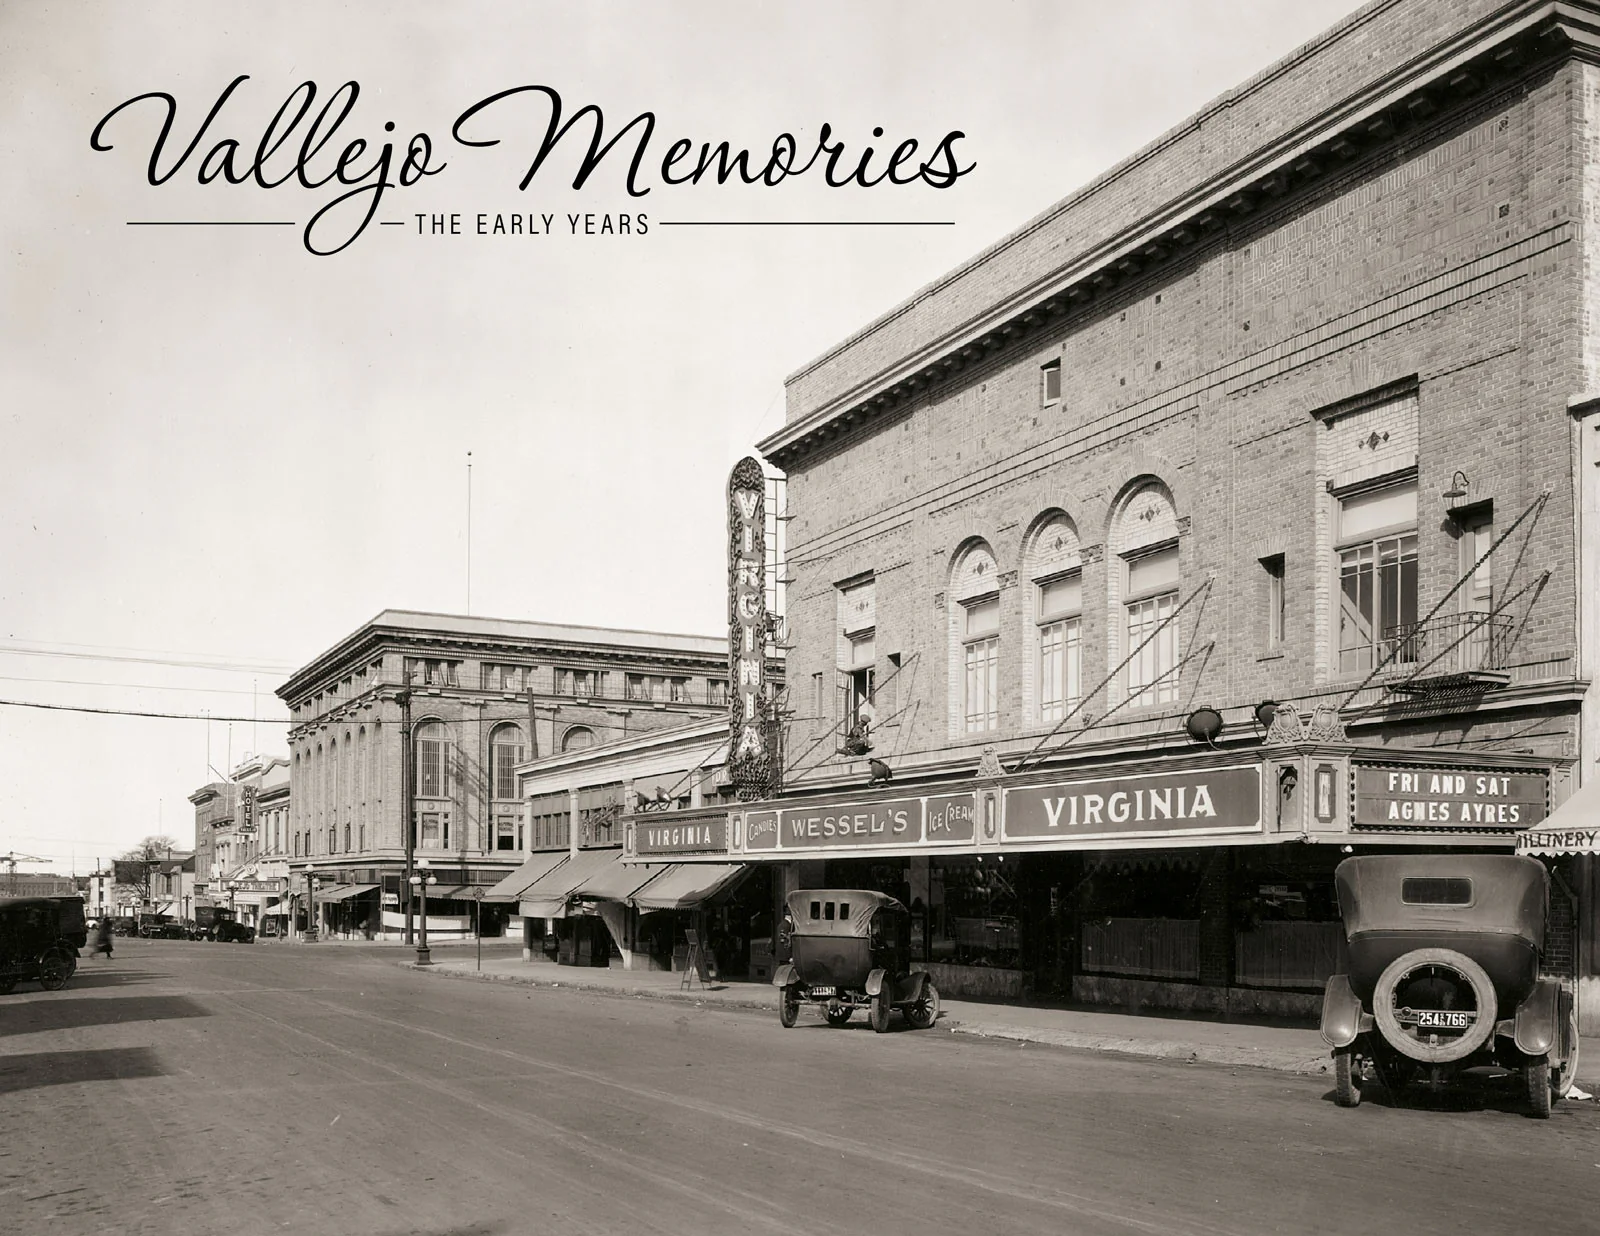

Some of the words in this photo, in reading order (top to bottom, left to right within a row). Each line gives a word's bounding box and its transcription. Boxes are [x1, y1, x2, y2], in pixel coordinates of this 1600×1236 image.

[735, 489, 761, 752] VIRGINIA
[1388, 773, 1419, 793] FRI
[1430, 775, 1466, 794] AND
[1476, 777, 1511, 796] SAT
[1042, 785, 1218, 827] VIRGINIA
[1388, 802, 1450, 821] AGNES
[1460, 803, 1520, 823] AYRES
[748, 819, 777, 841] CANDIES
[791, 809, 908, 837] WESSEL'S
[929, 811, 943, 833] ICE
[649, 826, 711, 846] VIRGINIA
